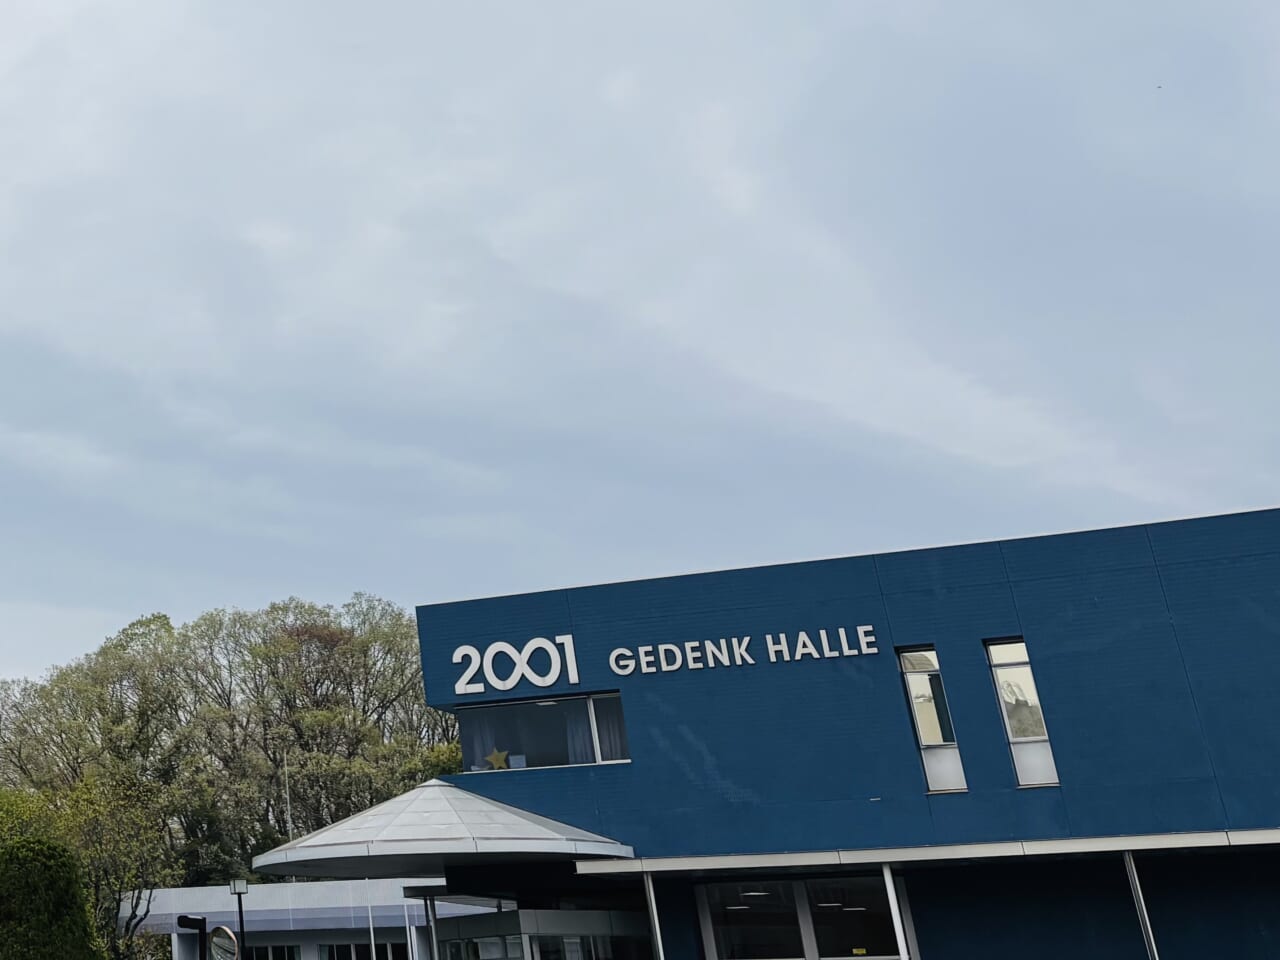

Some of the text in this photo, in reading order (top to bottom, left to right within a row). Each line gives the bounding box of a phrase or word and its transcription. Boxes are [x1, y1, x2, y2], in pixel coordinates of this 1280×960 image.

[452, 625, 879, 695] 2001 GEDENK HALLE
